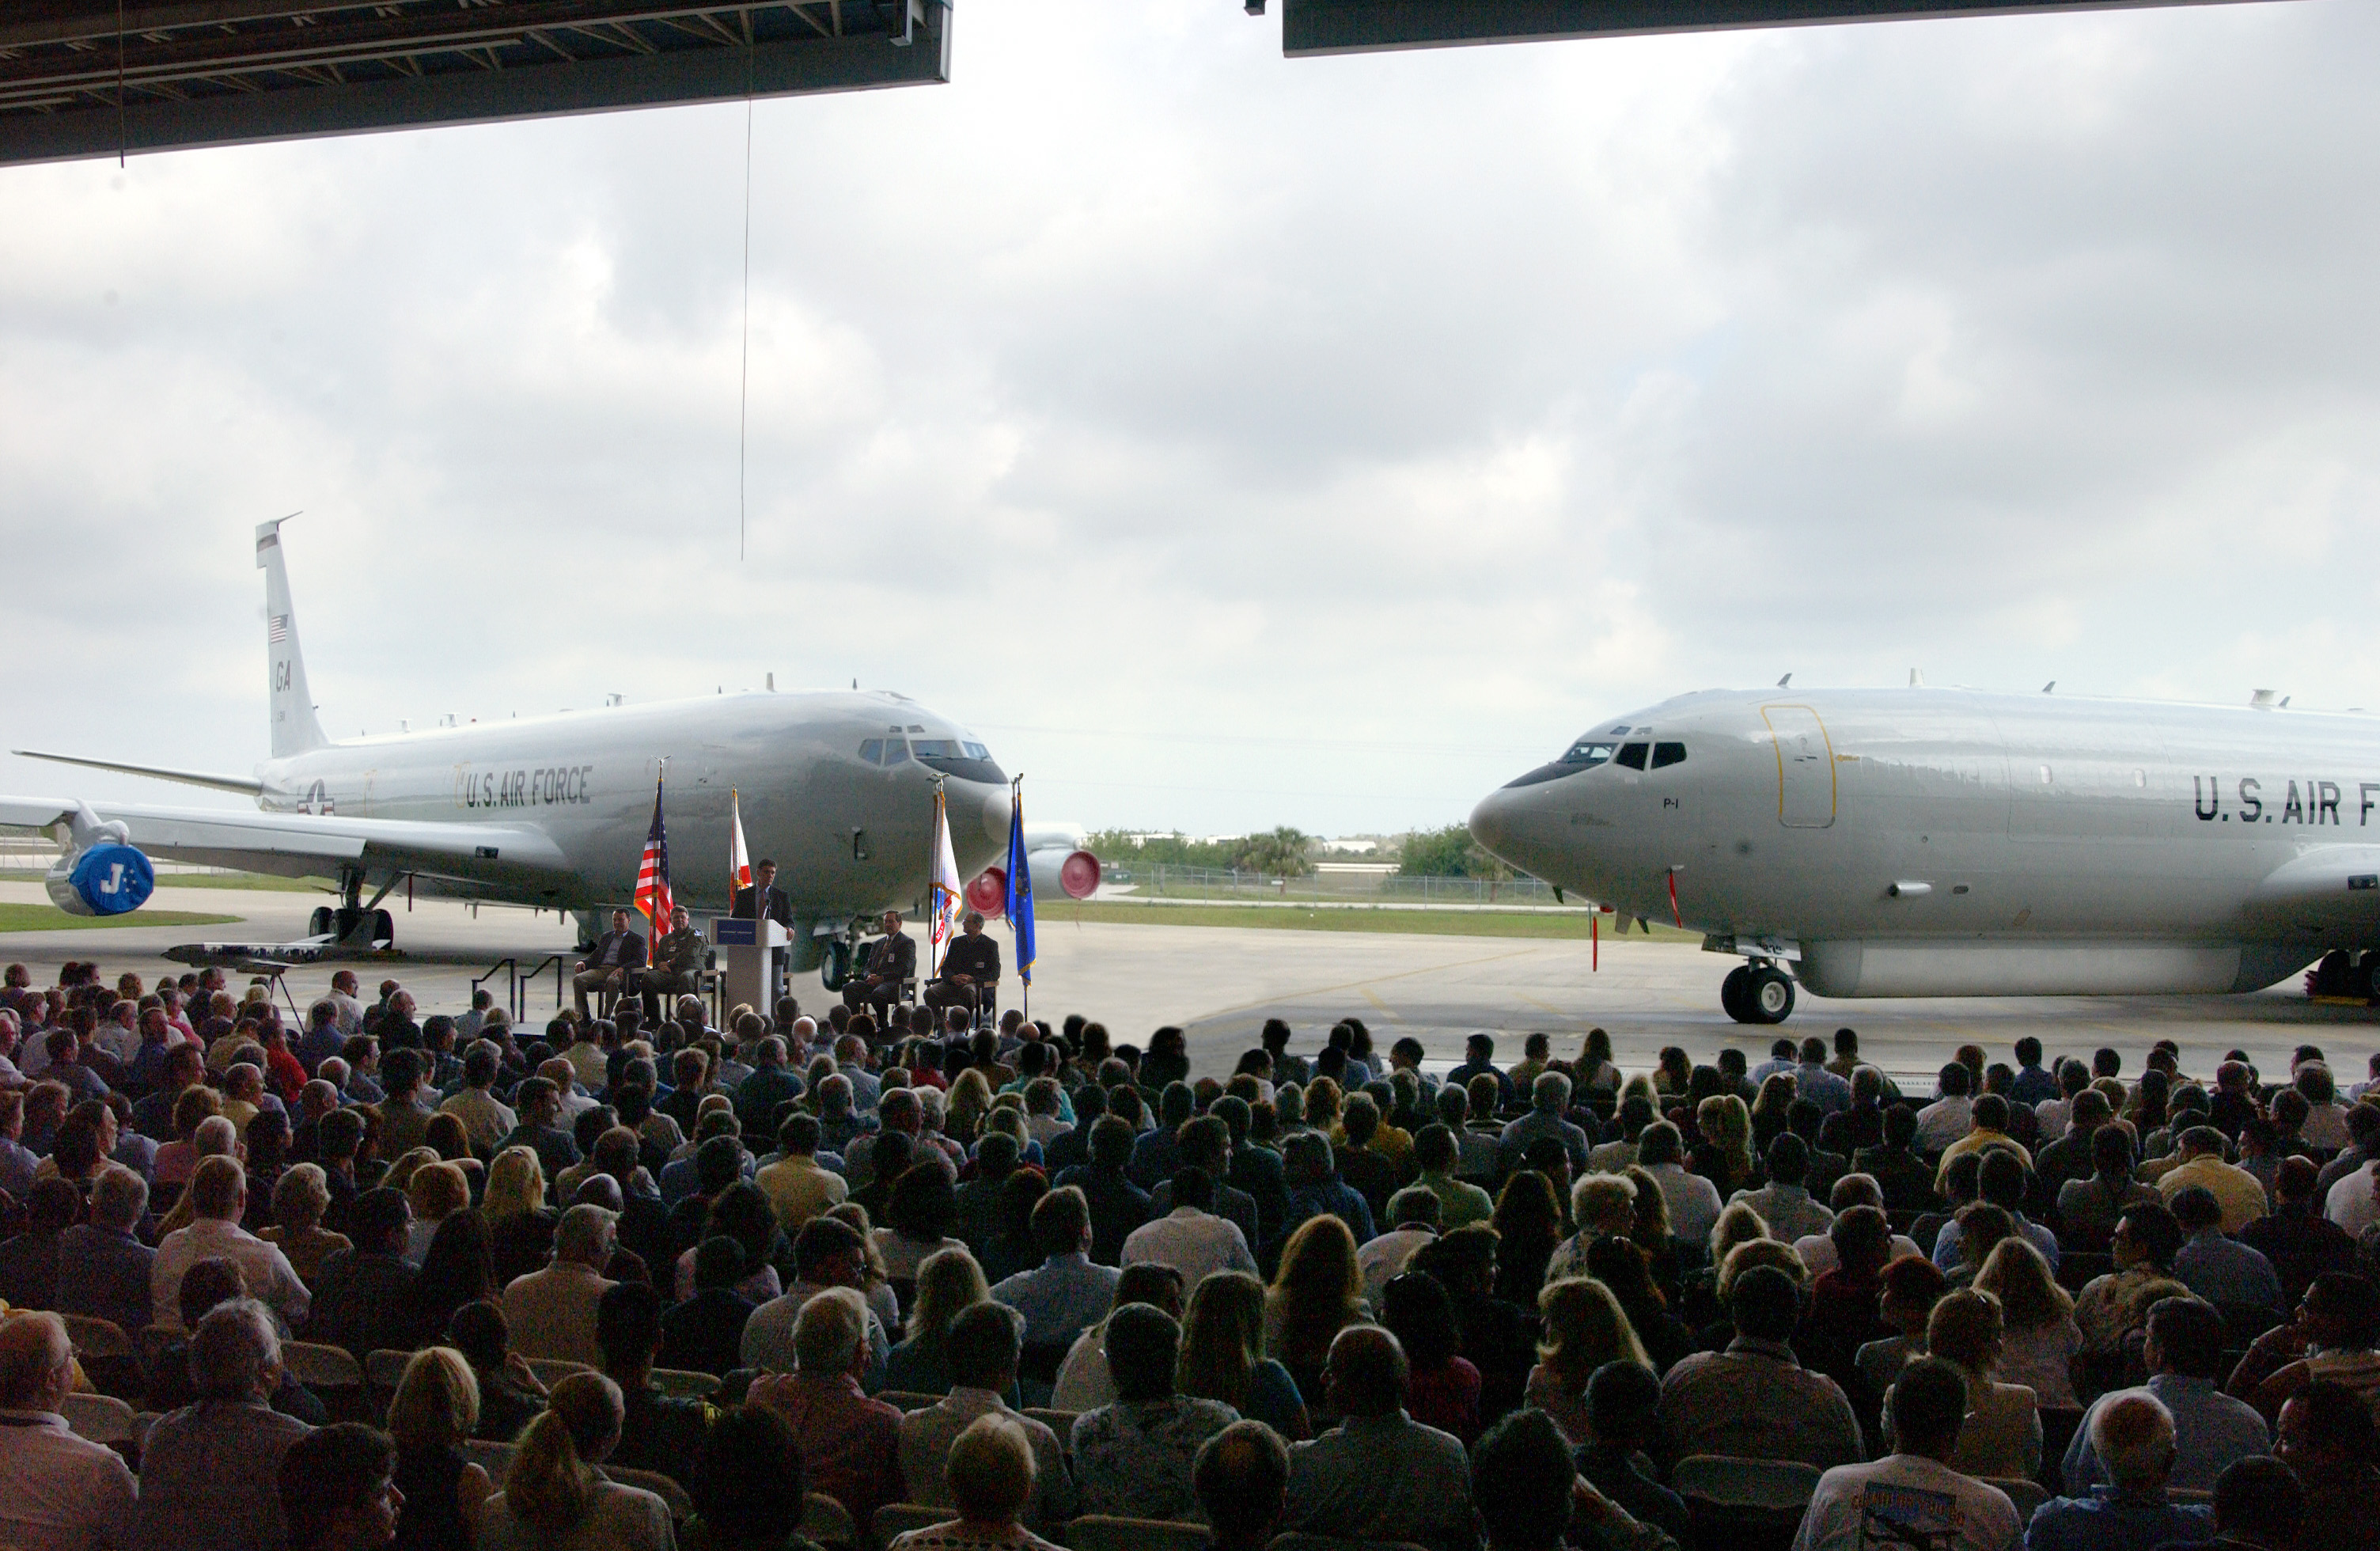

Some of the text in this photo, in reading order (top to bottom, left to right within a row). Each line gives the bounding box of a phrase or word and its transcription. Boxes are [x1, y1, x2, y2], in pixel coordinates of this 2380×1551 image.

[276, 660, 290, 692] GA
[467, 765, 593, 807] U.S. AIR FORCE
[2193, 776, 2272, 822] U.S.
[2282, 779, 2340, 825] AIR
[100, 863, 125, 894] J
